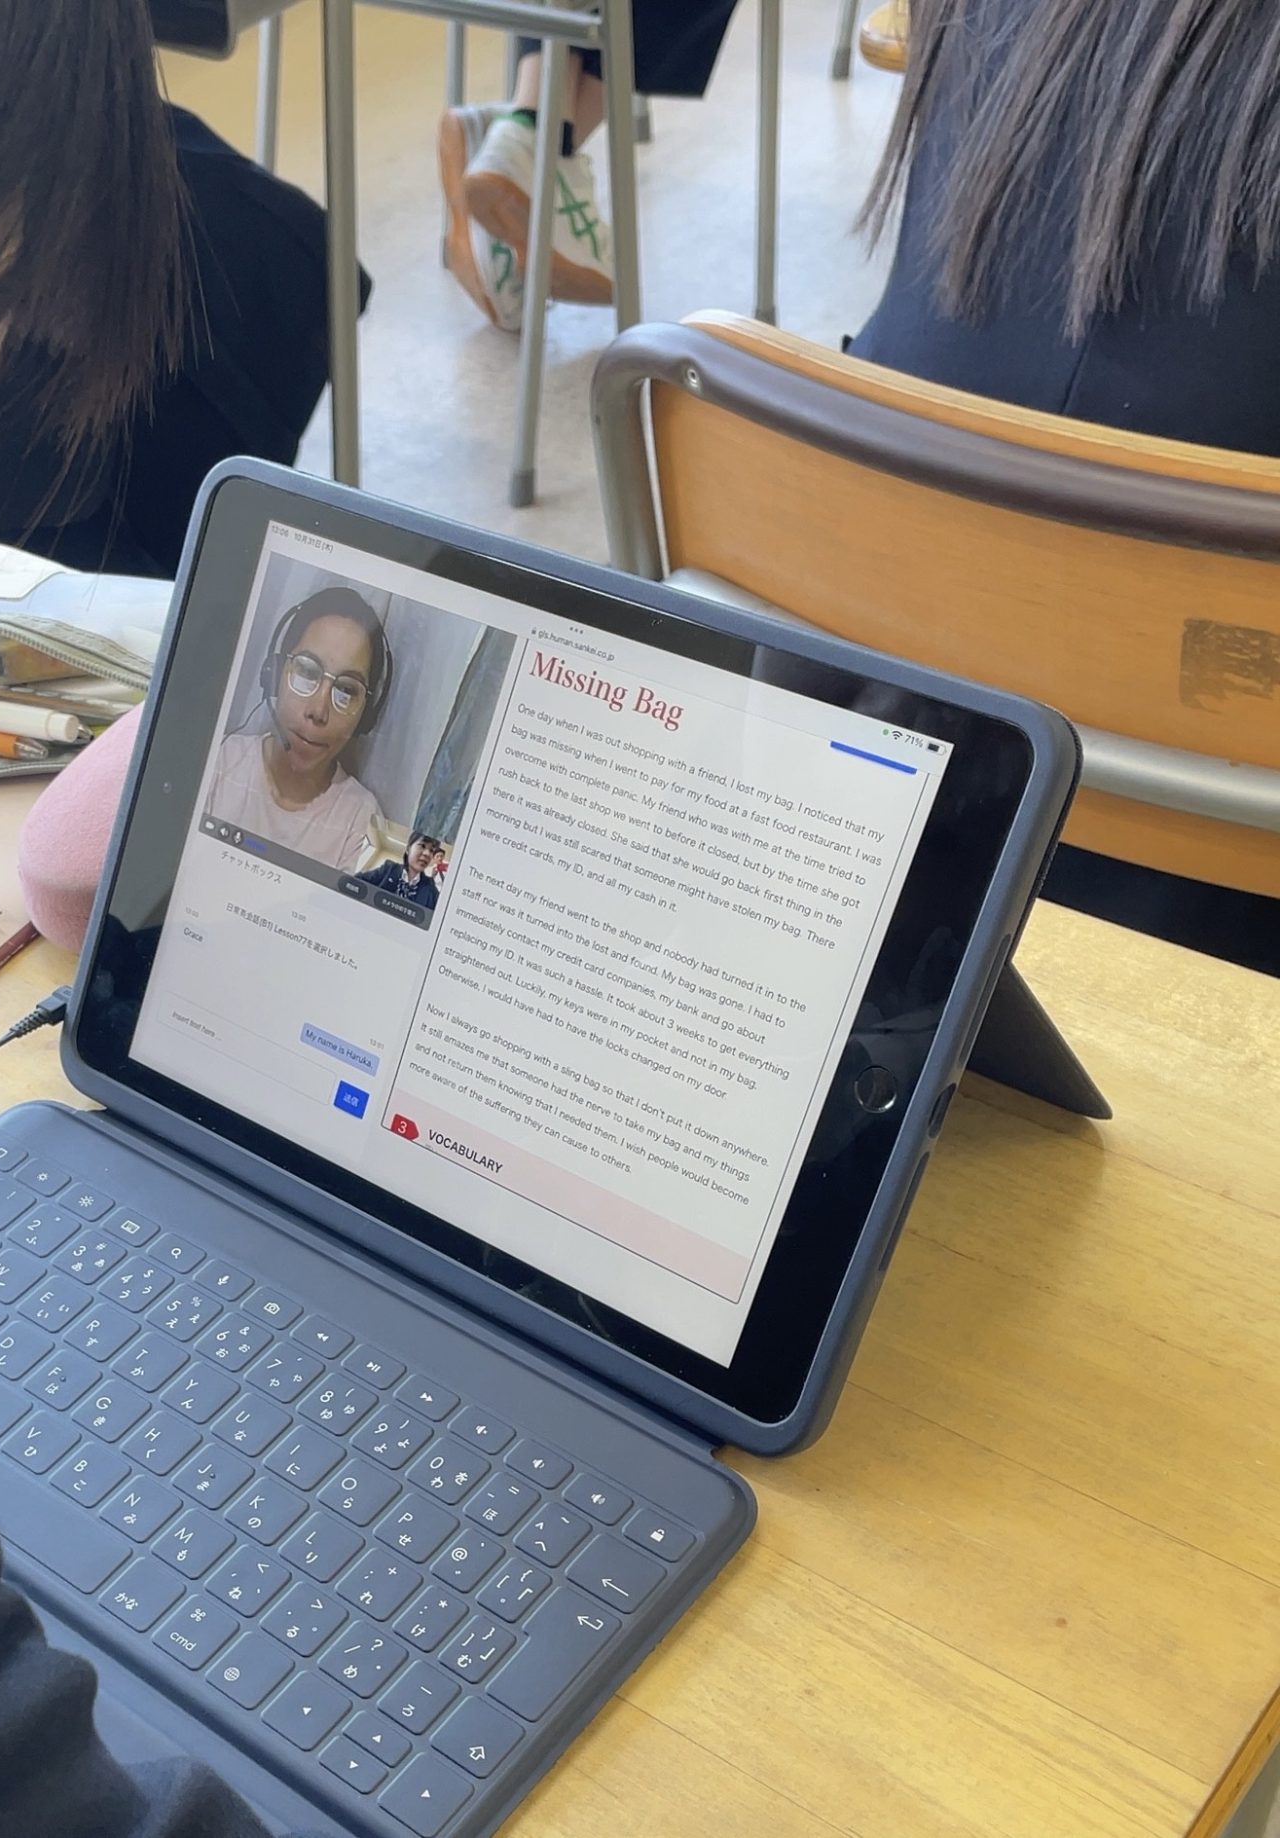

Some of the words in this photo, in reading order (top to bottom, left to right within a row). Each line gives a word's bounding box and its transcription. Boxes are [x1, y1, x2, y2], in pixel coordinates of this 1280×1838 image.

[529, 651, 629, 713] Missing
[632, 686, 684, 732] Bag
[904, 734, 924, 748] 71%
[517, 702, 536, 717] One
[536, 710, 554, 724] day
[555, 717, 580, 733] when
[585, 729, 604, 741] was
[604, 736, 621, 748] out
[622, 739, 666, 765] shopping
[667, 757, 687, 771] with
[688, 765, 695, 774] a
[735, 779, 755, 796] lost
[755, 789, 772, 803] my
[773, 793, 796, 811] bag.
[802, 806, 843, 826] noticed
[844, 819, 866, 835] that
[867, 828, 885, 843] my
[504, 746, 547, 768] overcome
[549, 762, 568, 776] with
[568, 768, 610, 792] complete
[640, 794, 657, 810] My
[657, 800, 687, 820] friend
[687, 811, 708, 827] who
[709, 821, 729, 835] was
[731, 829, 751, 843] with
[752, 837, 769, 850] me
[770, 842, 782, 855] at
[783, 847, 801, 861] the
[803, 854, 827, 871] time
[827, 863, 853, 880] tried
[853, 873, 866, 885] to
[221, 851, 282, 884] チャットボックス
[479, 827, 502, 842] were
[501, 834, 528, 853] credit
[528, 847, 555, 865] cards,
[556, 858, 572, 871] my
[571, 862, 586, 877] ID,
[586, 869, 606, 883] and
[604, 877, 617, 888] all
[616, 882, 633, 895] my
[632, 888, 658, 904] cash
[657, 895, 667, 909] in
[183, 927, 203, 943] Grace
[466, 864, 484, 880] The
[484, 873, 505, 889] next
[504, 881, 523, 897] day
[522, 890, 537, 903] my
[538, 894, 566, 914] friend
[566, 907, 589, 924] went
[590, 916, 600, 928] to
[601, 921, 617, 935] the
[618, 929, 642, 945] shop
[642, 939, 662, 953] and
[660, 947, 699, 970] nobody
[699, 960, 720, 976] had
[720, 970, 755, 991] turned
[754, 983, 763, 995] it
[763, 986, 775, 1000] in
[775, 991, 788, 1004] to
[789, 997, 806, 1012] the
[455, 905, 506, 936] immediately
[506, 927, 540, 949] contact
[540, 943, 556, 957] my
[554, 950, 583, 967] credit
[583, 959, 605, 976] card
[605, 971, 658, 1000] companies,
[658, 993, 675, 1008] my
[674, 998, 699, 1016] bank
[700, 1008, 720, 1025] and
[719, 1019, 734, 1033] go
[735, 1023, 765, 1044] about
[305, 1029, 318, 1042] My
[317, 1035, 338, 1052] name
[338, 1043, 346, 1055] is
[346, 1048, 374, 1069] Haruka.
[414, 1042, 431, 1055] and
[431, 1050, 446, 1063] not
[446, 1057, 473, 1076] return
[474, 1069, 497, 1086] them
[497, 1079, 533, 1105] knowing
[534, 1097, 553, 1113] that
[558, 1107, 593, 1131] needed
[593, 1125, 619, 1144] them.
[625, 1139, 648, 1157] wish
[646, 1151, 679, 1172] people
[680, 1164, 710, 1187] would
[709, 1179, 749, 1205] become
[397, 1121, 407, 1135] 3
[428, 1129, 504, 1174] VOCABULARY
[27, 1219, 42, 1231] 2
[72, 1245, 87, 1257] 3
[120, 1274, 134, 1284] 4
[39, 1291, 55, 1304] E
[166, 1300, 182, 1312] 5
[85, 1319, 101, 1332] R
[216, 1330, 230, 1341] 6
[0, 1336, 15, 1349] D
[135, 1348, 149, 1360] T
[266, 1358, 283, 1369] 7
[47, 1366, 62, 1377] F
[185, 1378, 199, 1391] Y
[95, 1396, 112, 1410] G
[319, 1390, 334, 1403] 8
[235, 1410, 251, 1424] U
[27, 1426, 42, 1439] V
[144, 1427, 161, 1442] H
[374, 1422, 389, 1434] 9
[73, 1459, 88, 1472] B
[197, 1463, 213, 1474] J
[123, 1492, 141, 1507] N
[249, 1495, 265, 1510] K
[343, 1497, 354, 1509] ら
[247, 1517, 262, 1529] の
[397, 1512, 414, 1524] P
[174, 1527, 194, 1544] M
[304, 1531, 317, 1545] L
[305, 1551, 319, 1564] り
[114, 1592, 139, 1610] かな
[169, 1632, 197, 1652] cmd
